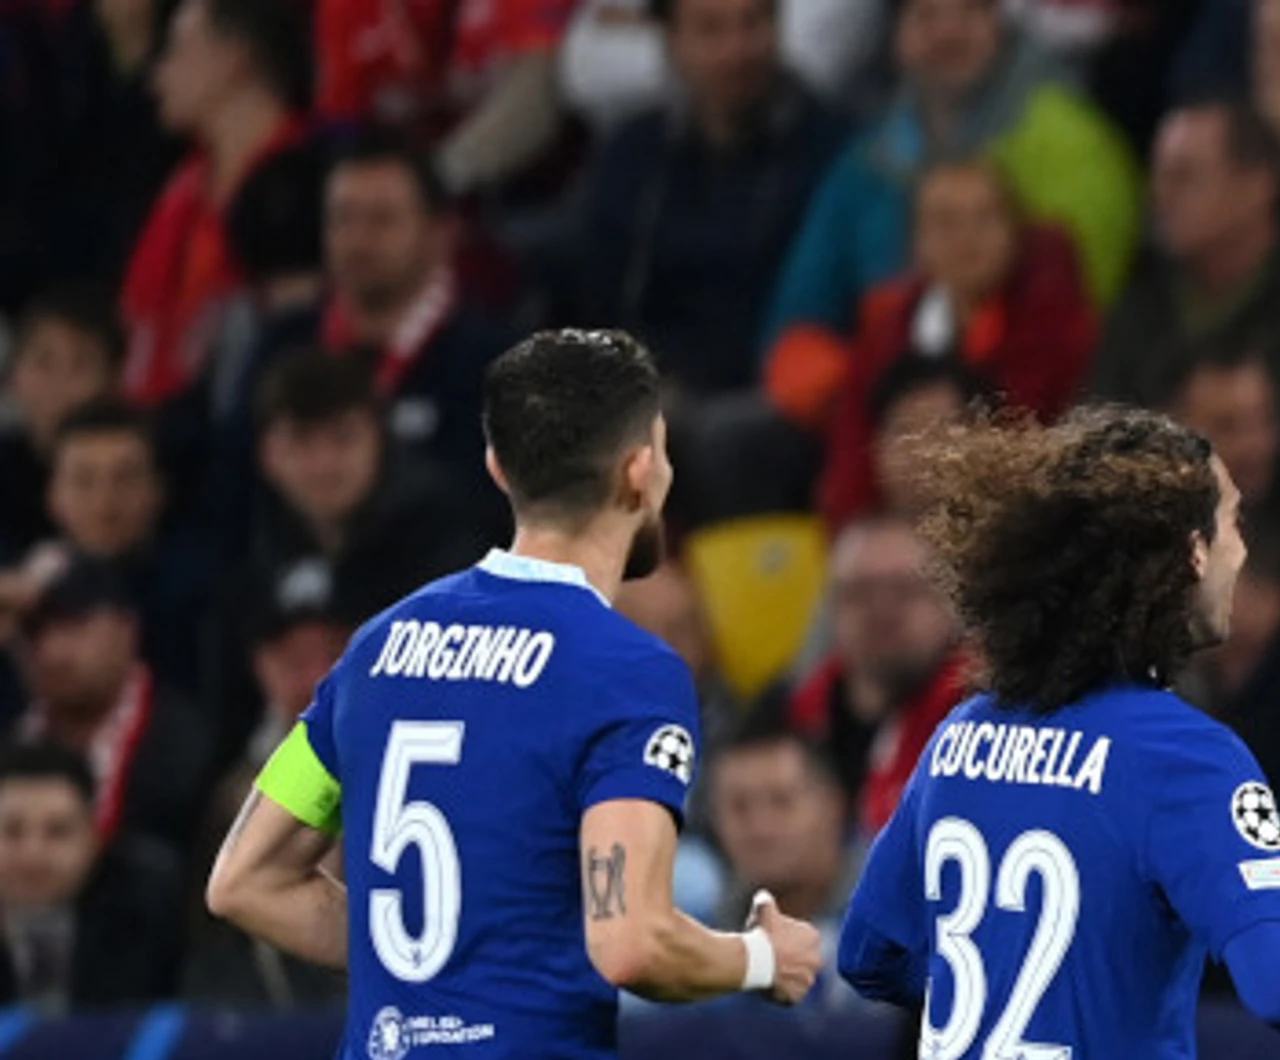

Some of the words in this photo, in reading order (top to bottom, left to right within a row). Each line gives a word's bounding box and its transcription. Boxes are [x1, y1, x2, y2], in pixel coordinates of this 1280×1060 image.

[369, 618, 555, 688] JORGINHO
[930, 721, 1112, 795] CUCURELLA
[369, 720, 466, 983] 5
